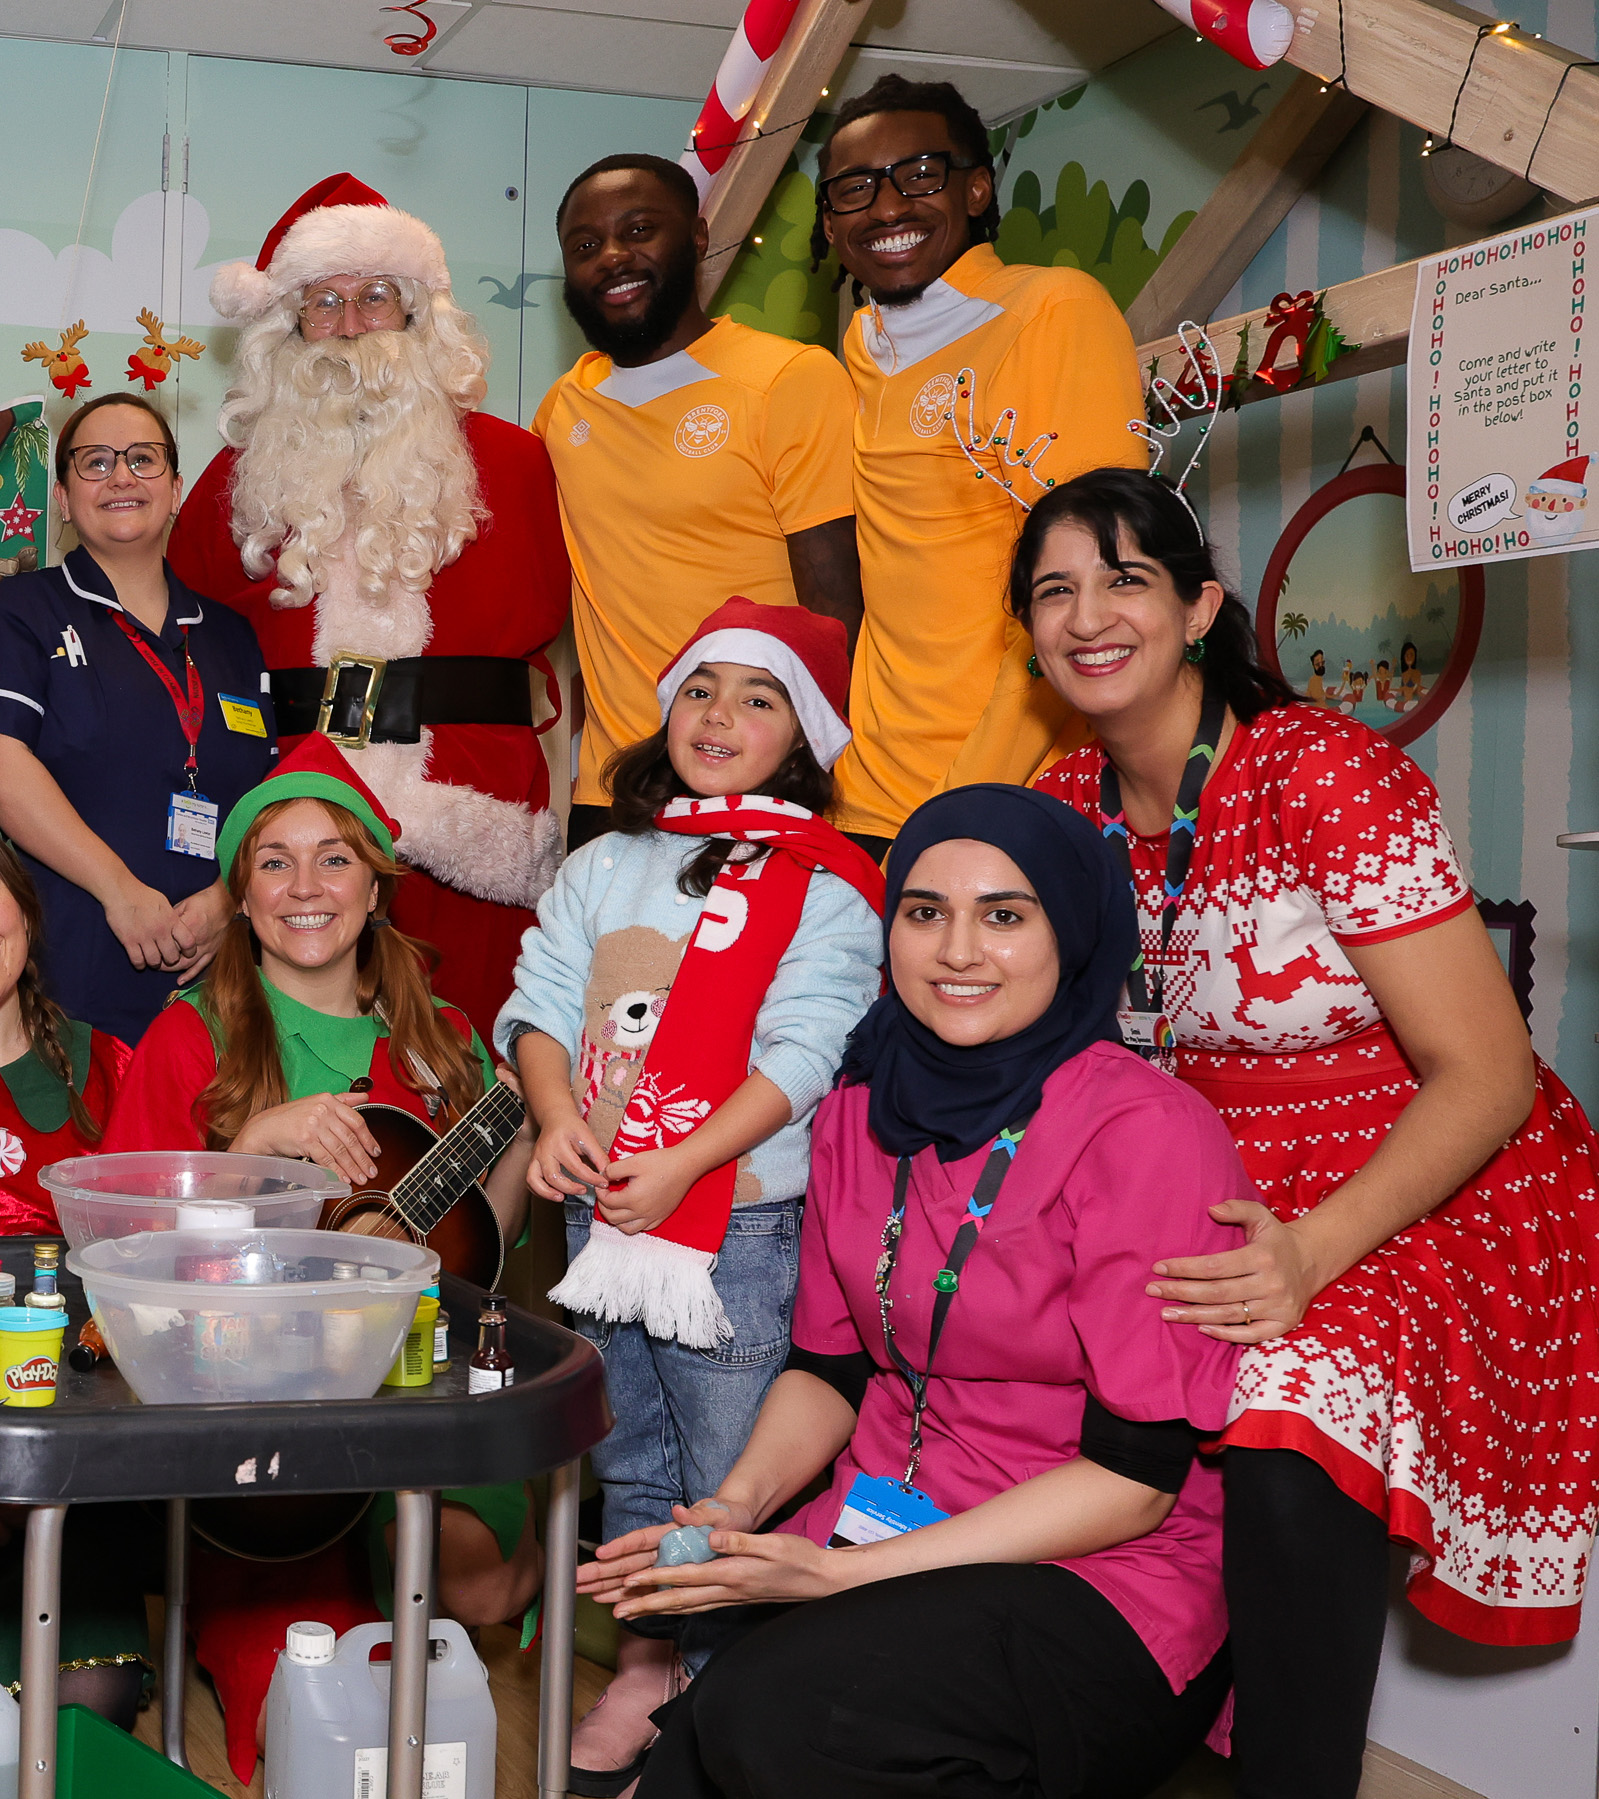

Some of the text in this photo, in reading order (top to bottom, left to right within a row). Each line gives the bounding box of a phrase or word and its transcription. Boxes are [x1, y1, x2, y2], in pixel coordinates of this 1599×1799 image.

[1456, 275, 1542, 305] Dear Santa...
[1459, 340, 1556, 372] Come and write
[1454, 369, 1558, 402] Santa and put it
[1464, 358, 1548, 391] your letter to
[686, 407, 726, 421] BRENTFORD
[1458, 388, 1553, 416] in the post box
[1484, 409, 1524, 427] below!
[1457, 489, 1510, 525] CHRISTMAS!
[1461, 483, 1492, 507] MERRY
[232, 705, 253, 717] Bethany
[6, 1362, 58, 1387] Play-Do
[866, 1507, 886, 1521] Service
[887, 1516, 908, 1531] Identity
